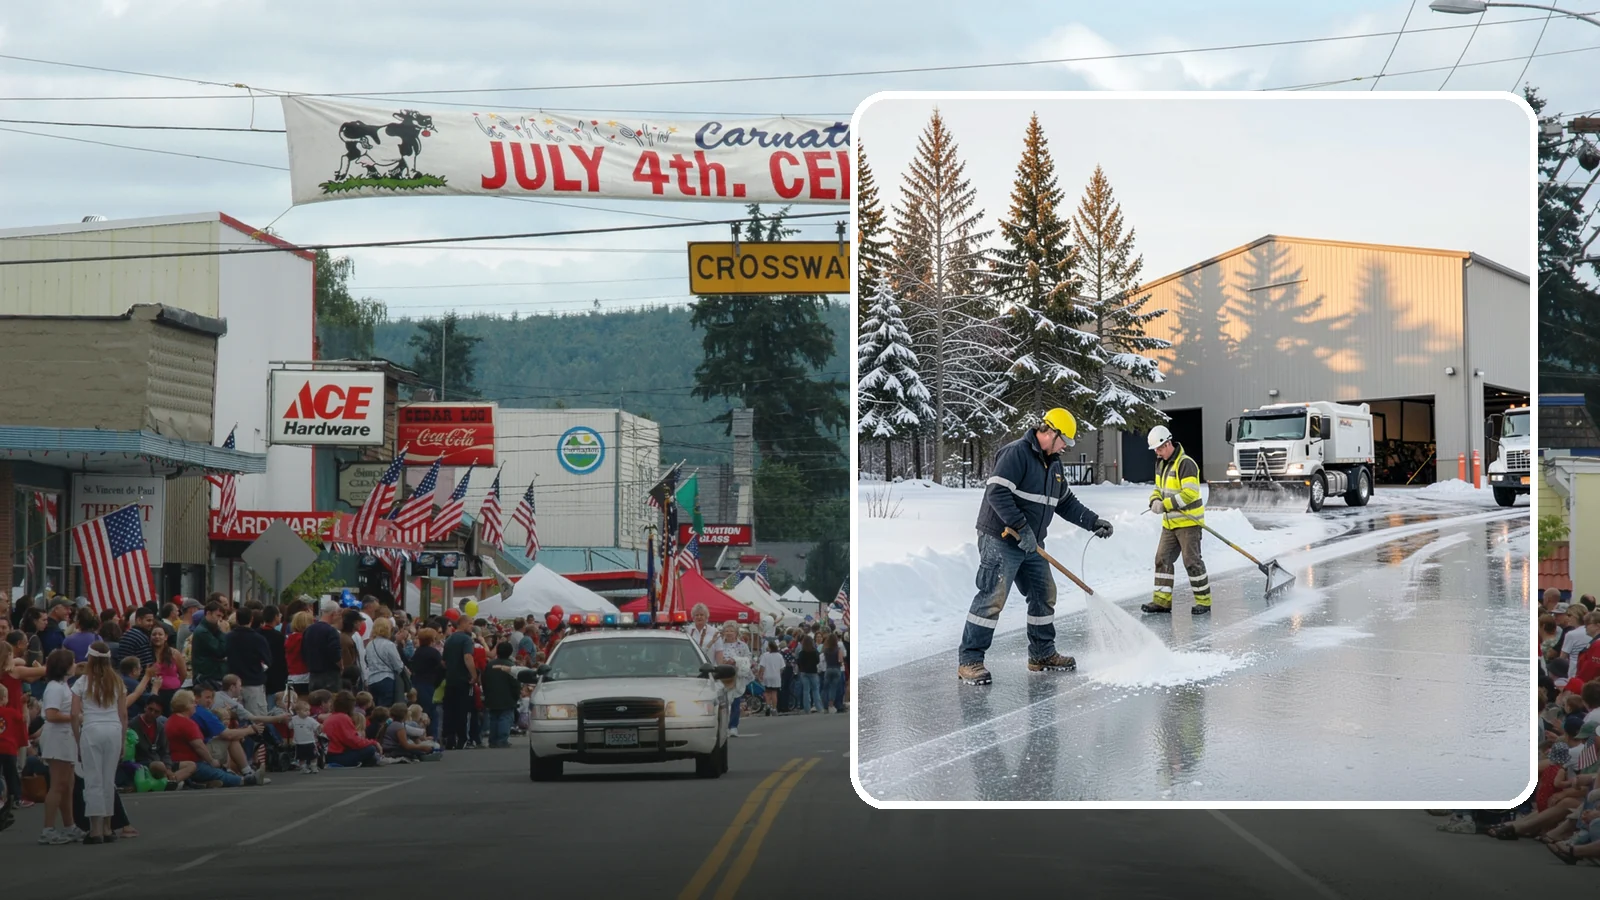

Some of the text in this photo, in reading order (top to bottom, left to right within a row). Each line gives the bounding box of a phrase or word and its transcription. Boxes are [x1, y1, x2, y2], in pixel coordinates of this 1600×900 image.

[481, 141, 604, 193] JULY
[632, 149, 746, 198] 4th.
[697, 254, 850, 280] CROSSWA
[283, 380, 373, 420] ACE
[405, 409, 453, 422] CEDAR
[283, 421, 371, 436] Hardware
[416, 428, 477, 447] Coca-Cola
[353, 466, 386, 479] Simpl
[83, 484, 155, 495] St. Vincent de Paul
[699, 535, 730, 543] GLASS
